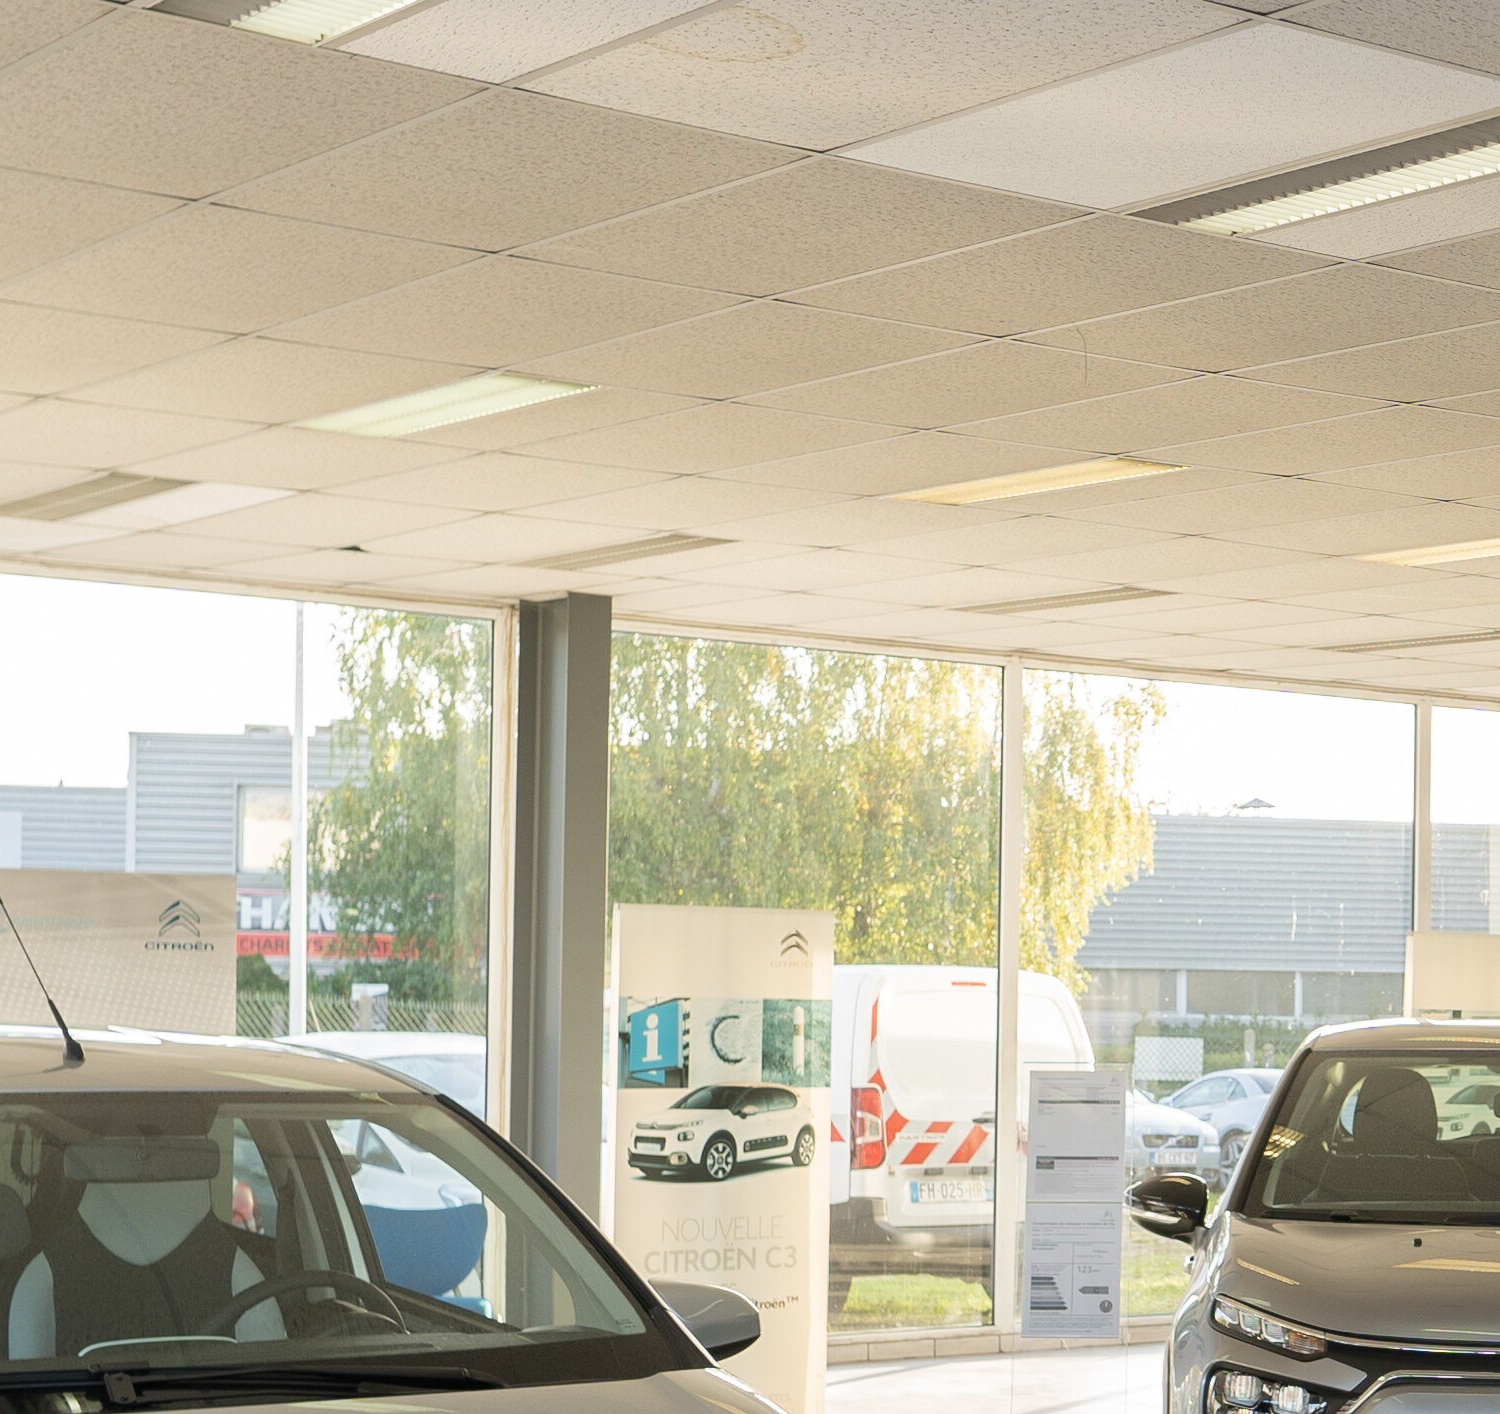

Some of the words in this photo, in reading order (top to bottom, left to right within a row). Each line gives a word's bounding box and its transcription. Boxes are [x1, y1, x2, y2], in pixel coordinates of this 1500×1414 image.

[661, 1215, 784, 1243] NOUVELLE
[644, 1243, 757, 1275] CITROËN
[765, 1245, 797, 1270] C3
